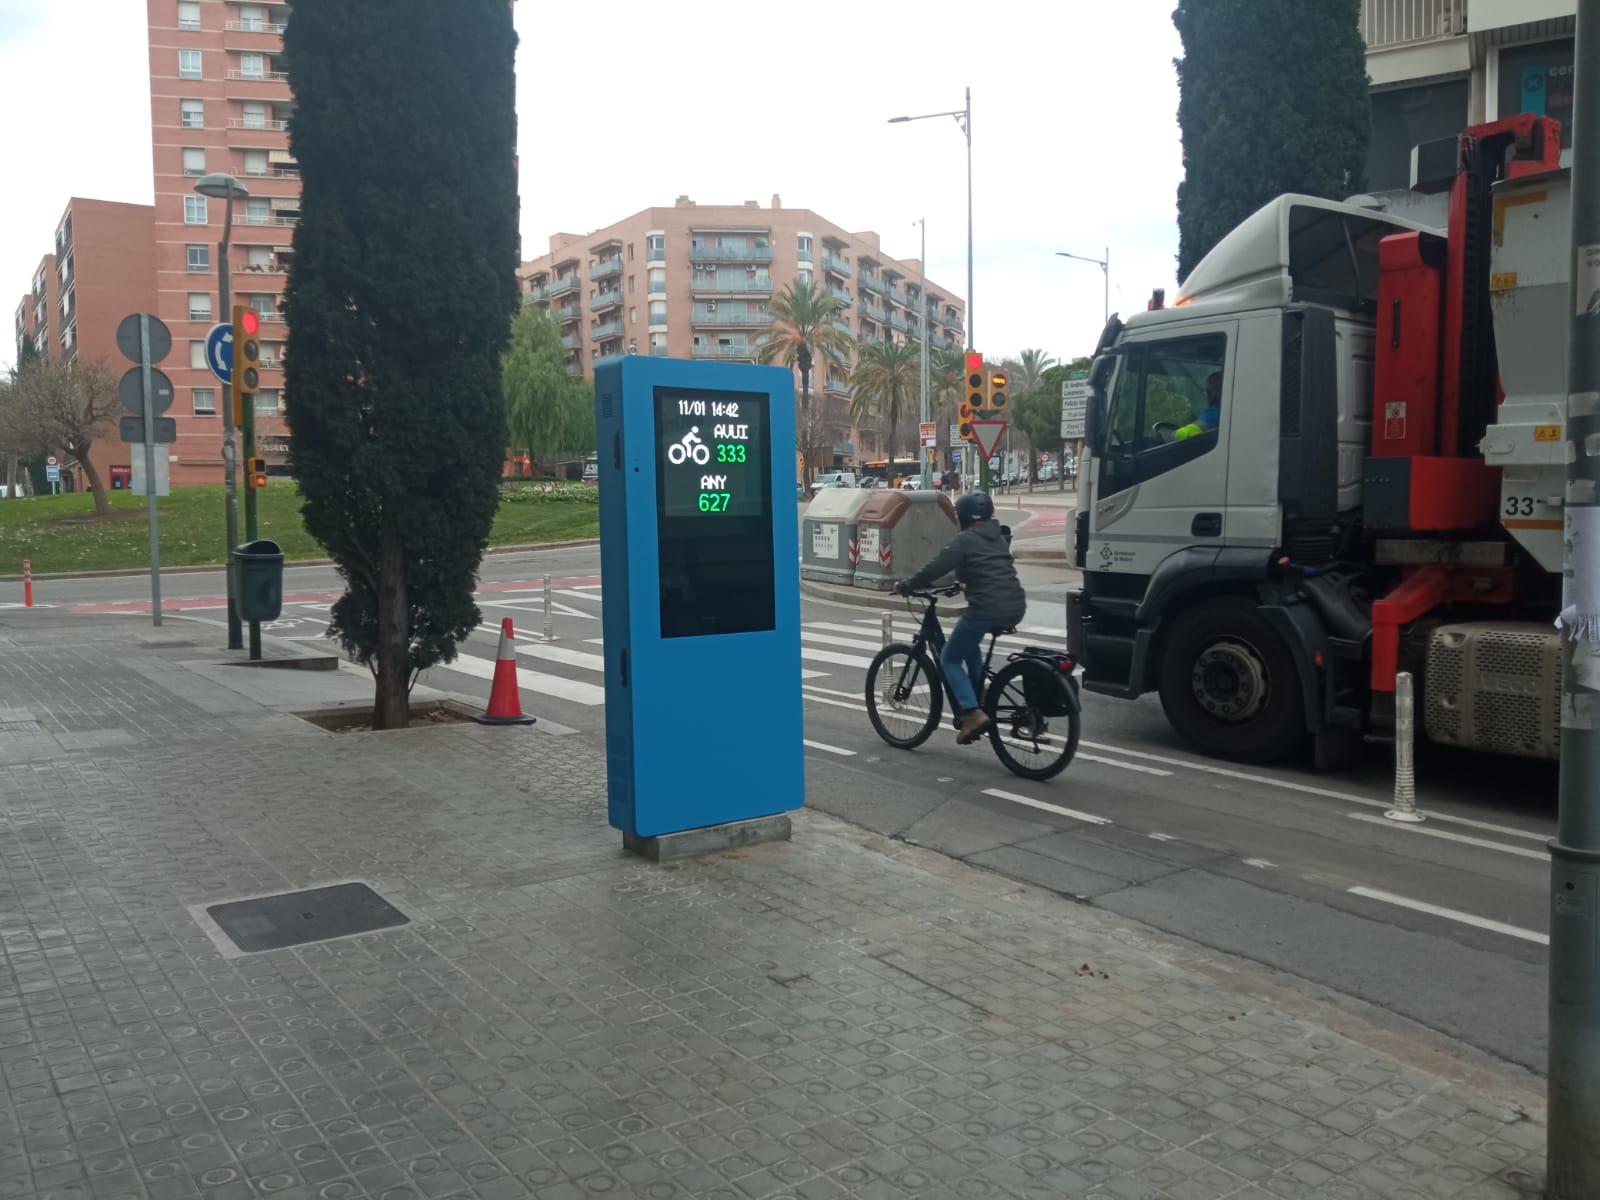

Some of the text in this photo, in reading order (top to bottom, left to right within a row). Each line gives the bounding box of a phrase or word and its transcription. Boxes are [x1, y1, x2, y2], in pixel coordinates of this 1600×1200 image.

[678, 400, 739, 417] 11/01 14:42
[714, 424, 748, 439] AVUI
[717, 444, 746, 463] 333
[701, 475, 727, 490] ANY
[699, 493, 730, 512] 627
[1505, 496, 1534, 516] 33
